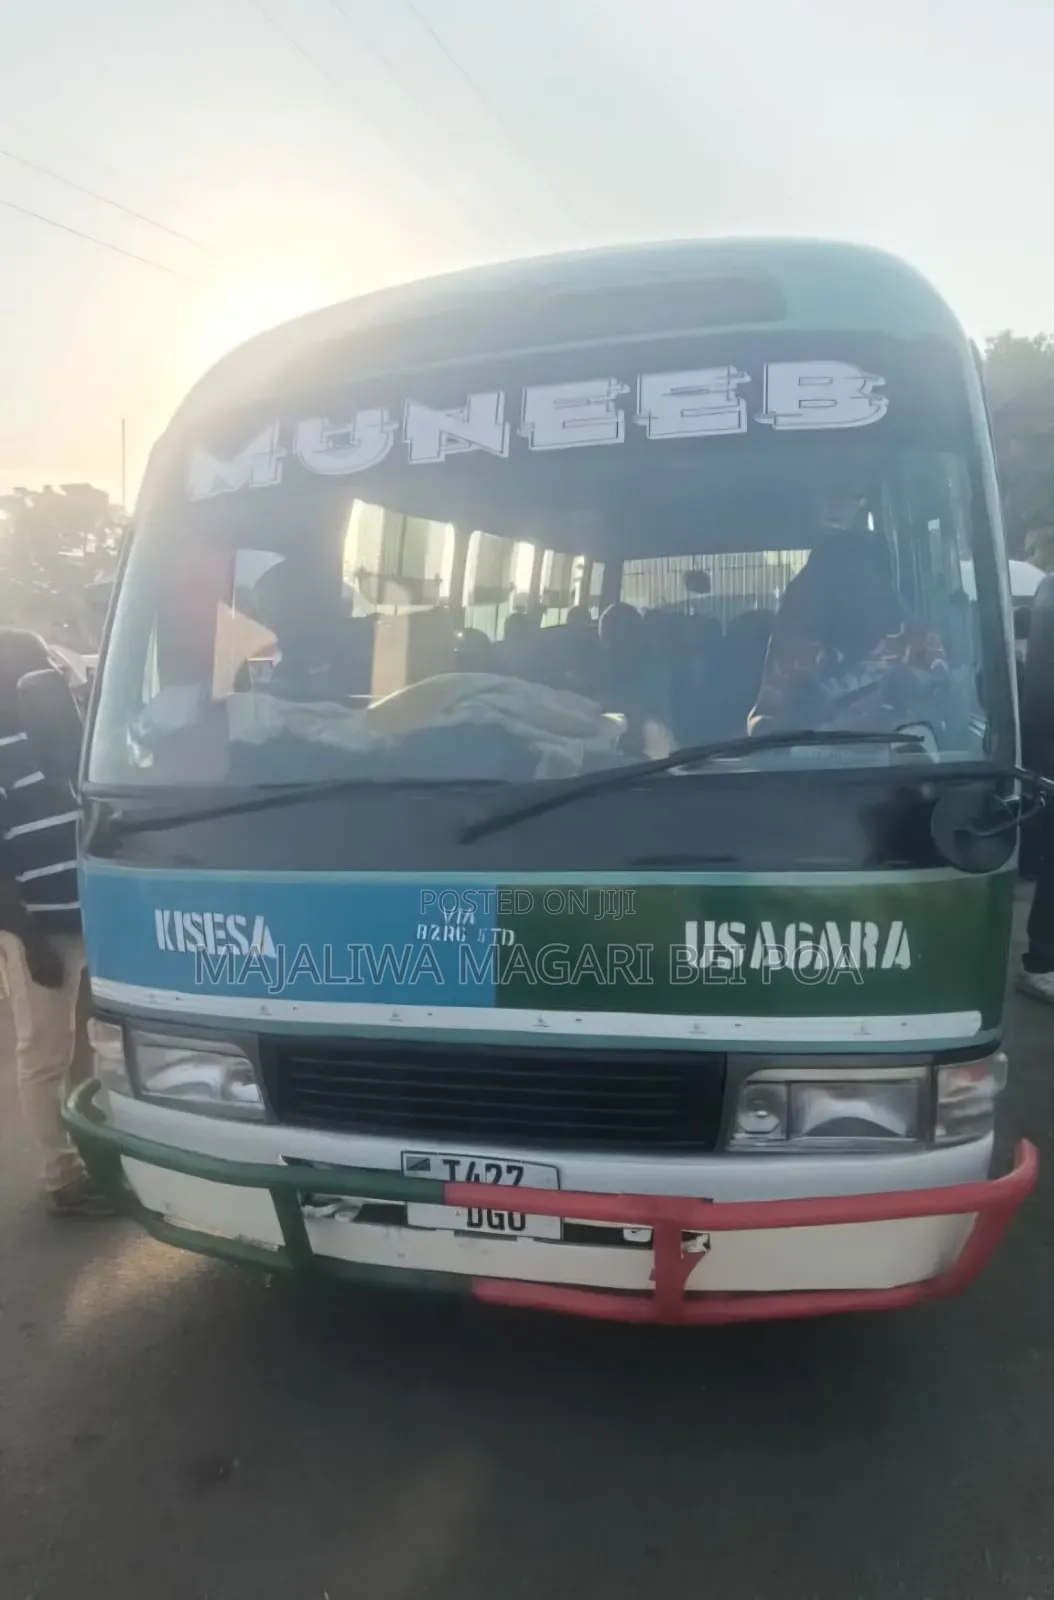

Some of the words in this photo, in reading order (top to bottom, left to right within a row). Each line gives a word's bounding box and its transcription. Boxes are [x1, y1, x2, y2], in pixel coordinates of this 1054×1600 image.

[186, 360, 888, 501] MUNEEB
[154, 908, 277, 959] KISESA
[684, 920, 911, 970] USAGARA
